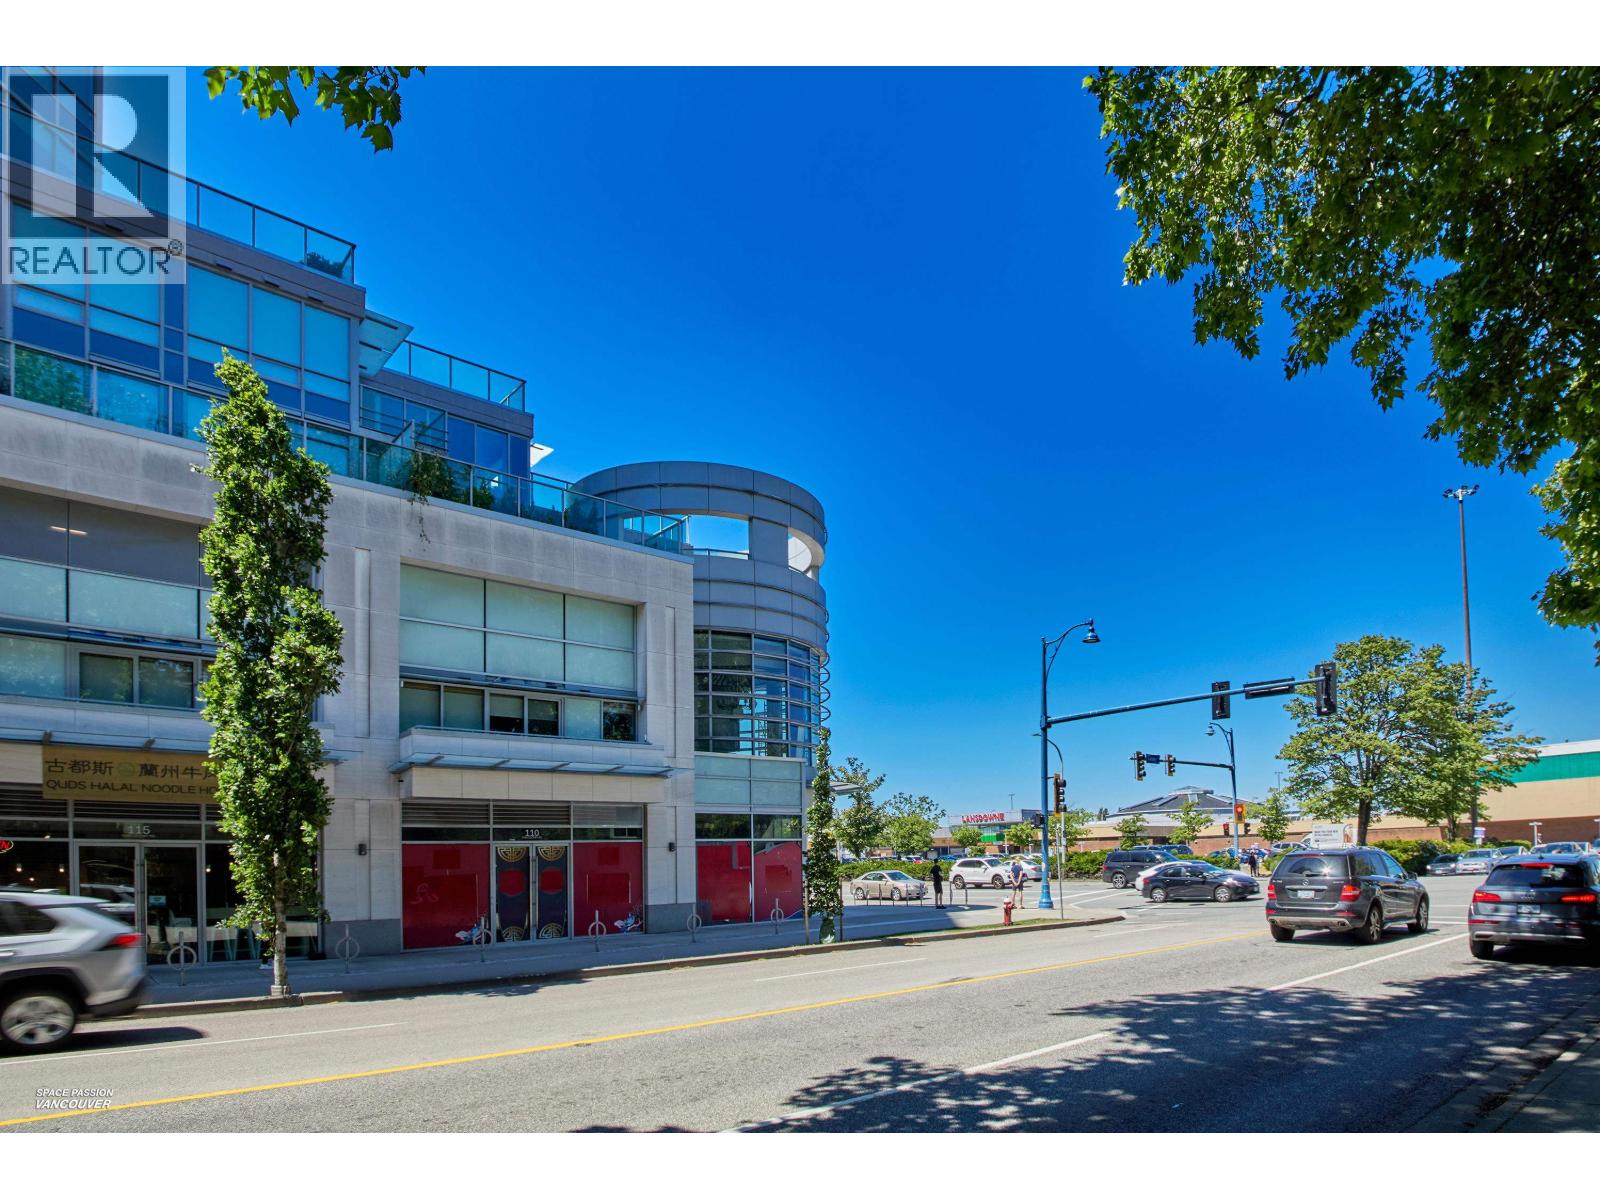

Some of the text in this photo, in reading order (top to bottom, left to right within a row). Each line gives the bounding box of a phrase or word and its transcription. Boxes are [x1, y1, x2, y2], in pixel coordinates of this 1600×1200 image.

[45, 758, 114, 777] 古都斯
[46, 779, 87, 791] QUDS
[90, 781, 137, 793] HALAL
[142, 783, 196, 794] NOODLE
[961, 812, 1005, 823] LANSDOWNE
[127, 825, 151, 835] 115
